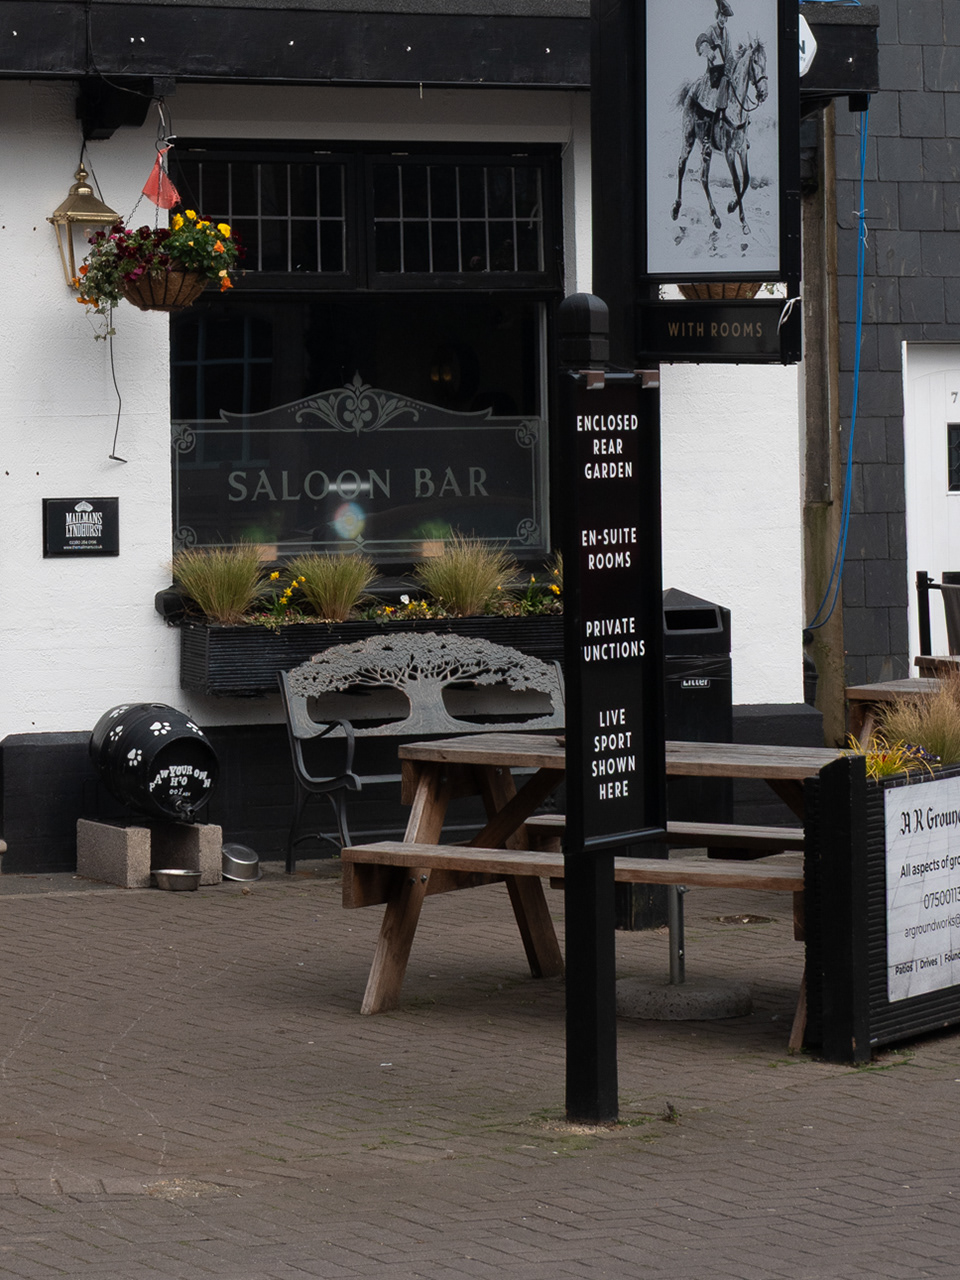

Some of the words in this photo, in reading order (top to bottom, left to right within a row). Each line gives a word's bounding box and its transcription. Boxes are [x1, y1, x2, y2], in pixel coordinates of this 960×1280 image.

[668, 322, 705, 338] WITH
[710, 322, 763, 337] ROOMS
[951, 391, 958, 403] 7
[577, 415, 638, 431] ENCLOSED
[594, 439, 622, 454] REAR
[585, 462, 632, 479] GARDEN
[228, 470, 391, 502] SALOON
[415, 467, 489, 498] BAR
[65, 512, 102, 525] MAILMANS
[65, 524, 102, 537] LYNDHURST
[582, 528, 636, 546] EN-SUITE
[589, 552, 630, 569] ROOMS
[587, 617, 635, 637] PRIVATE
[582, 640, 645, 661] UNCTIONS
[600, 709, 625, 727] LIVE
[595, 732, 631, 752] SPORT
[592, 756, 635, 776] SHOWN
[149, 770, 169, 792] PAW
[169, 765, 193, 776] YOUR
[193, 769, 211, 787] OWN
[600, 780, 628, 799] HERE
[900, 812, 911, 835] A
[914, 809, 924, 833] R
[900, 863, 911, 878] All
[912, 859, 940, 877] aspects
[941, 855, 949, 869] of
[895, 964, 913, 975] Patios
[920, 958, 938, 970] Drives
